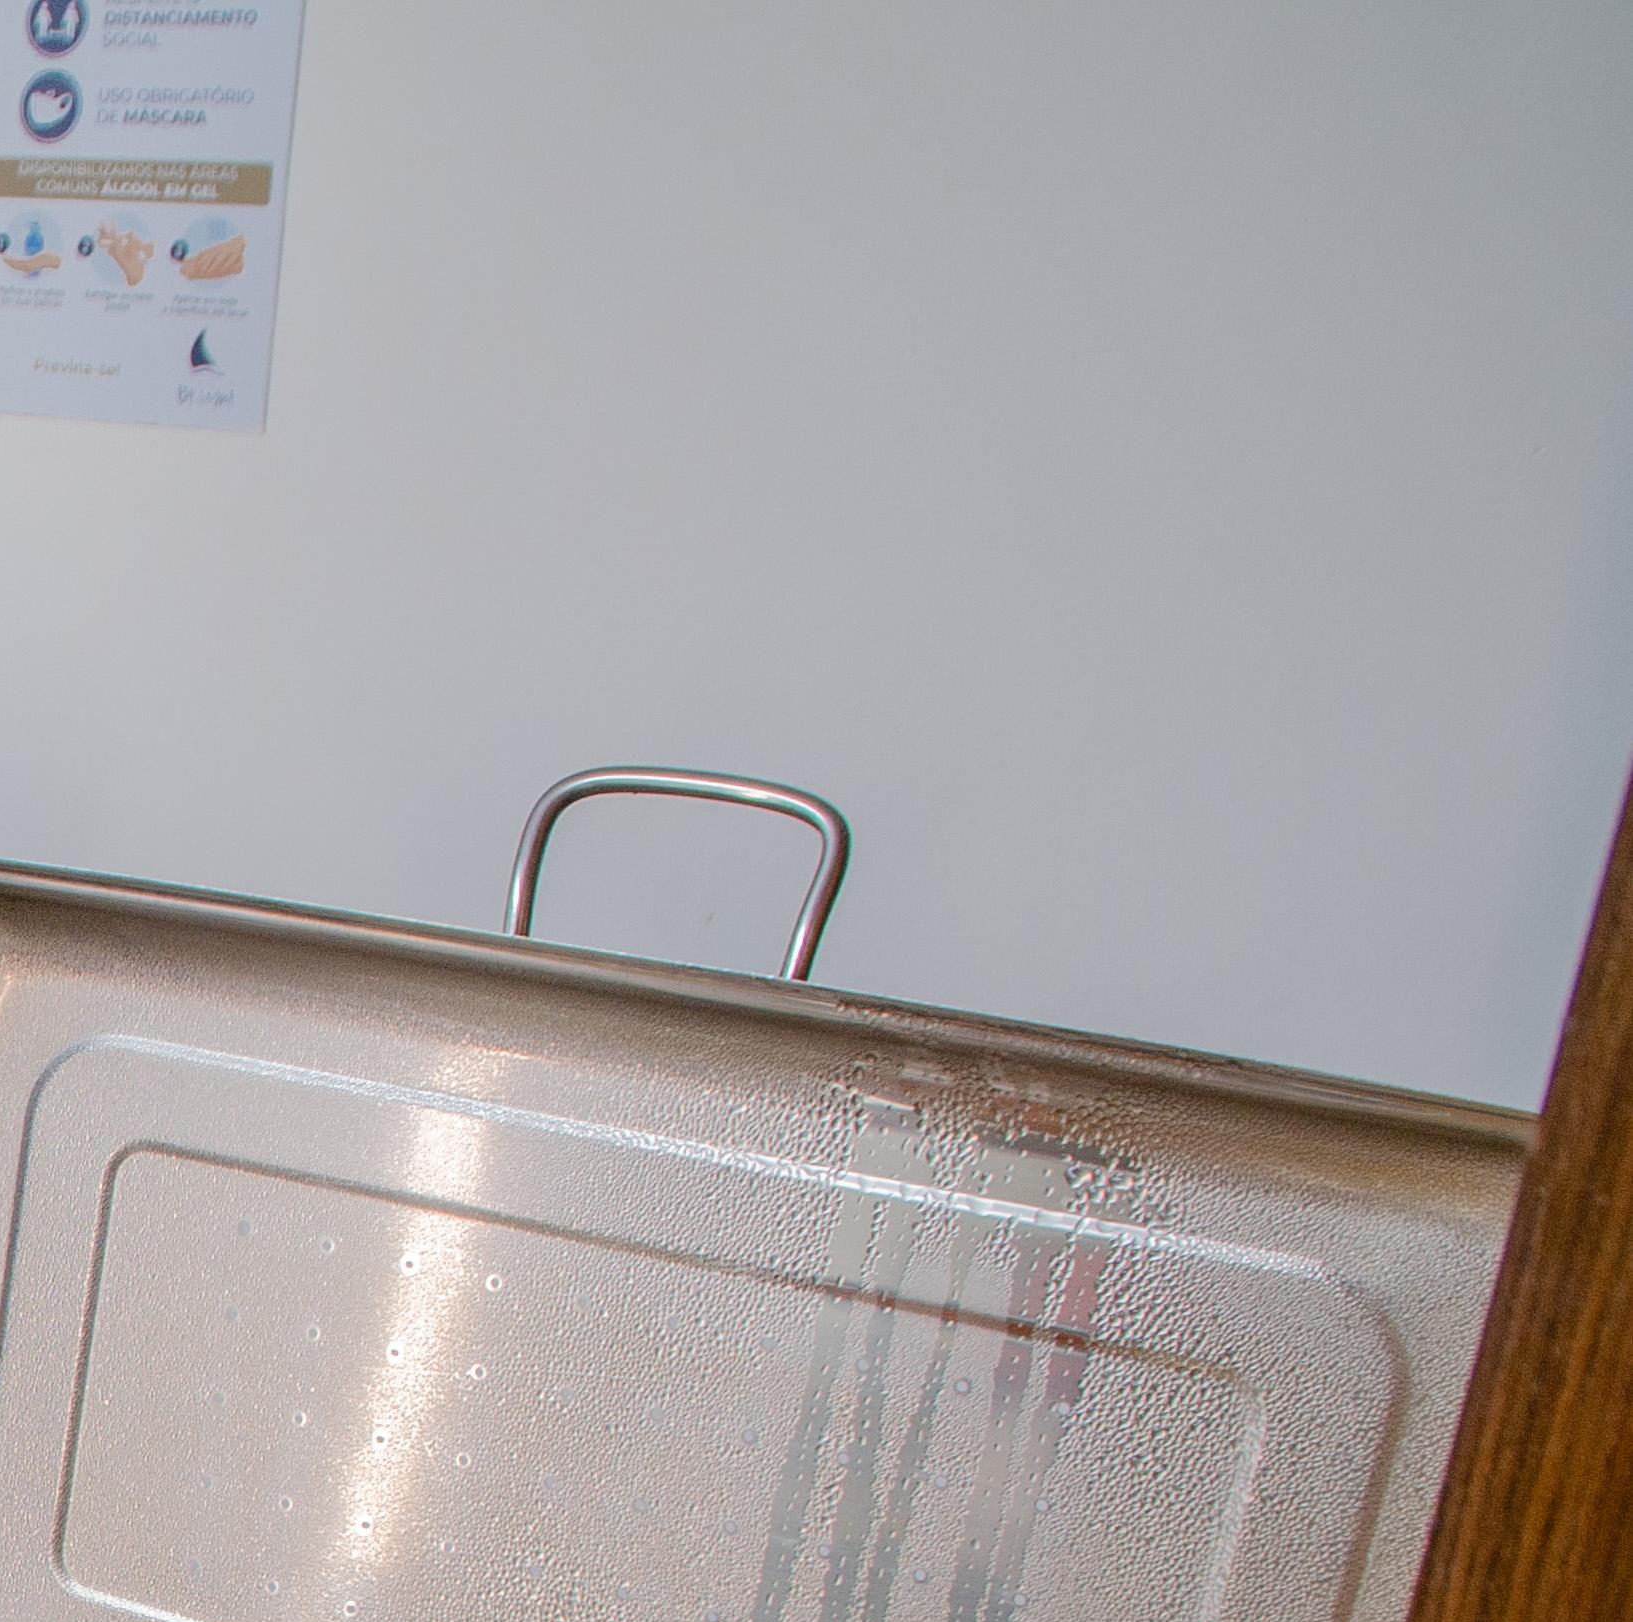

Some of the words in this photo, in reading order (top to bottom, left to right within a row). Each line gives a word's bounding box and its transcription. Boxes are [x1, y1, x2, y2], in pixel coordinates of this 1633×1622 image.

[104, 9, 259, 26] DISTANCIAMENTO
[103, 31, 161, 48] SOCIAL
[99, 87, 132, 103] USO
[137, 85, 255, 105] OBRIGATÓRIO
[96, 109, 119, 123] DE
[123, 106, 207, 125] MÁSCARA
